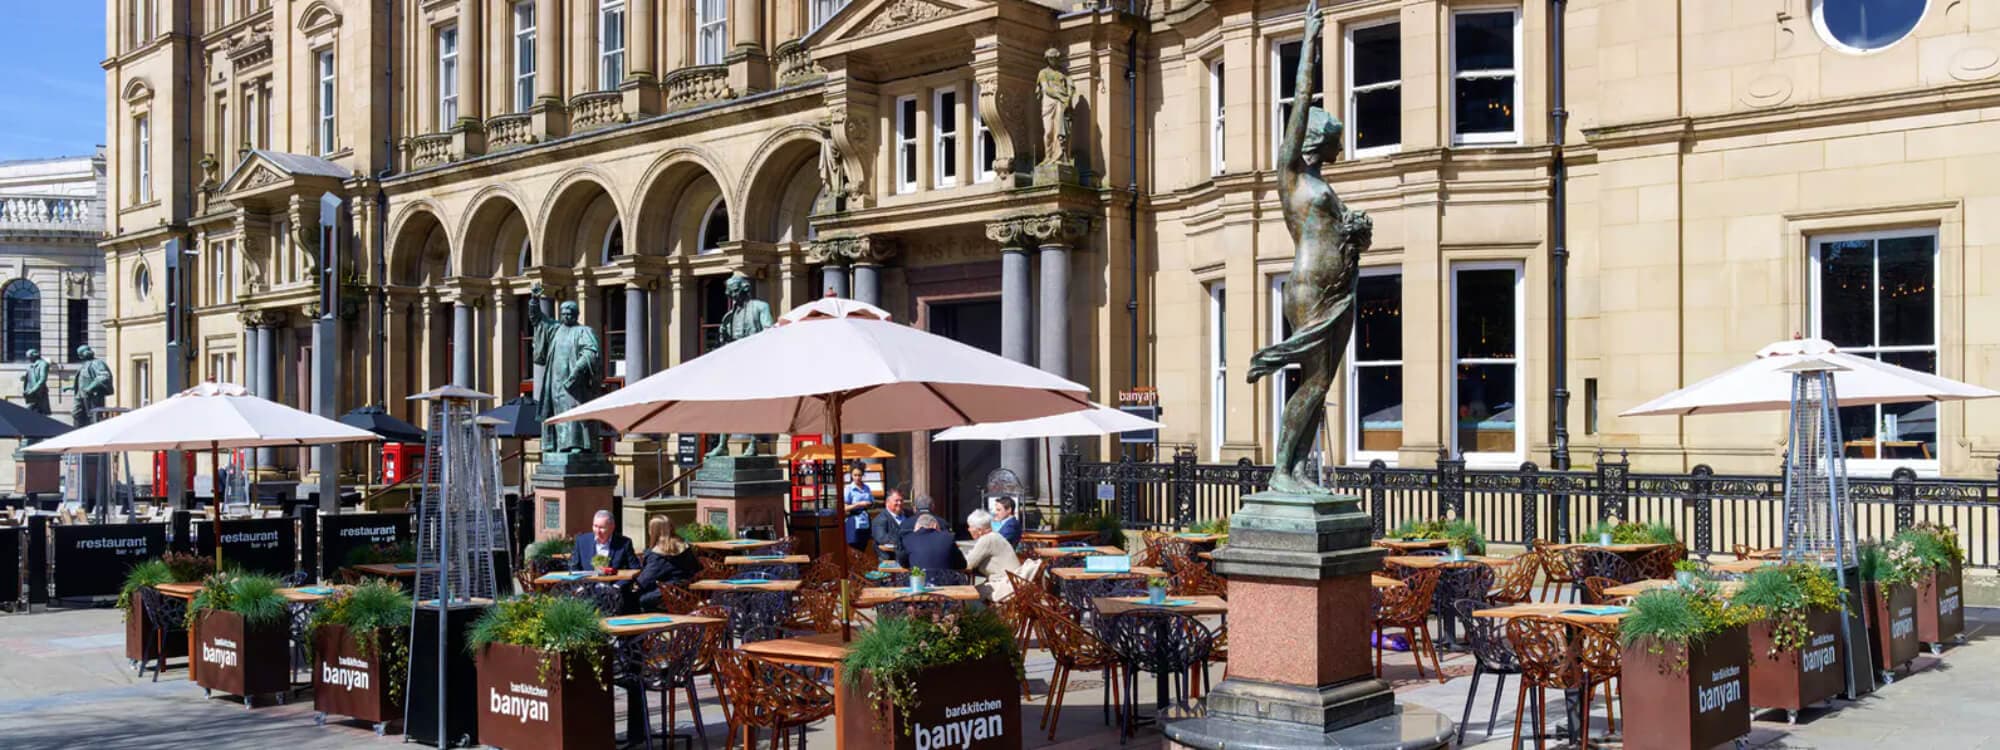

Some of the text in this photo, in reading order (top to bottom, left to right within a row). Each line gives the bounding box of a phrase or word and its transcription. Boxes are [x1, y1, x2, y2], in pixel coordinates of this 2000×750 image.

[1119, 390, 1156, 403] banyan
[203, 641, 237, 669] banyan
[1802, 645, 1836, 672] banyan
[323, 661, 369, 691] banyan
[490, 687, 549, 723] banyan
[945, 699, 1002, 718] bar&kitchen
[1698, 679, 1741, 713] banyan
[914, 713, 1003, 750] banyan
